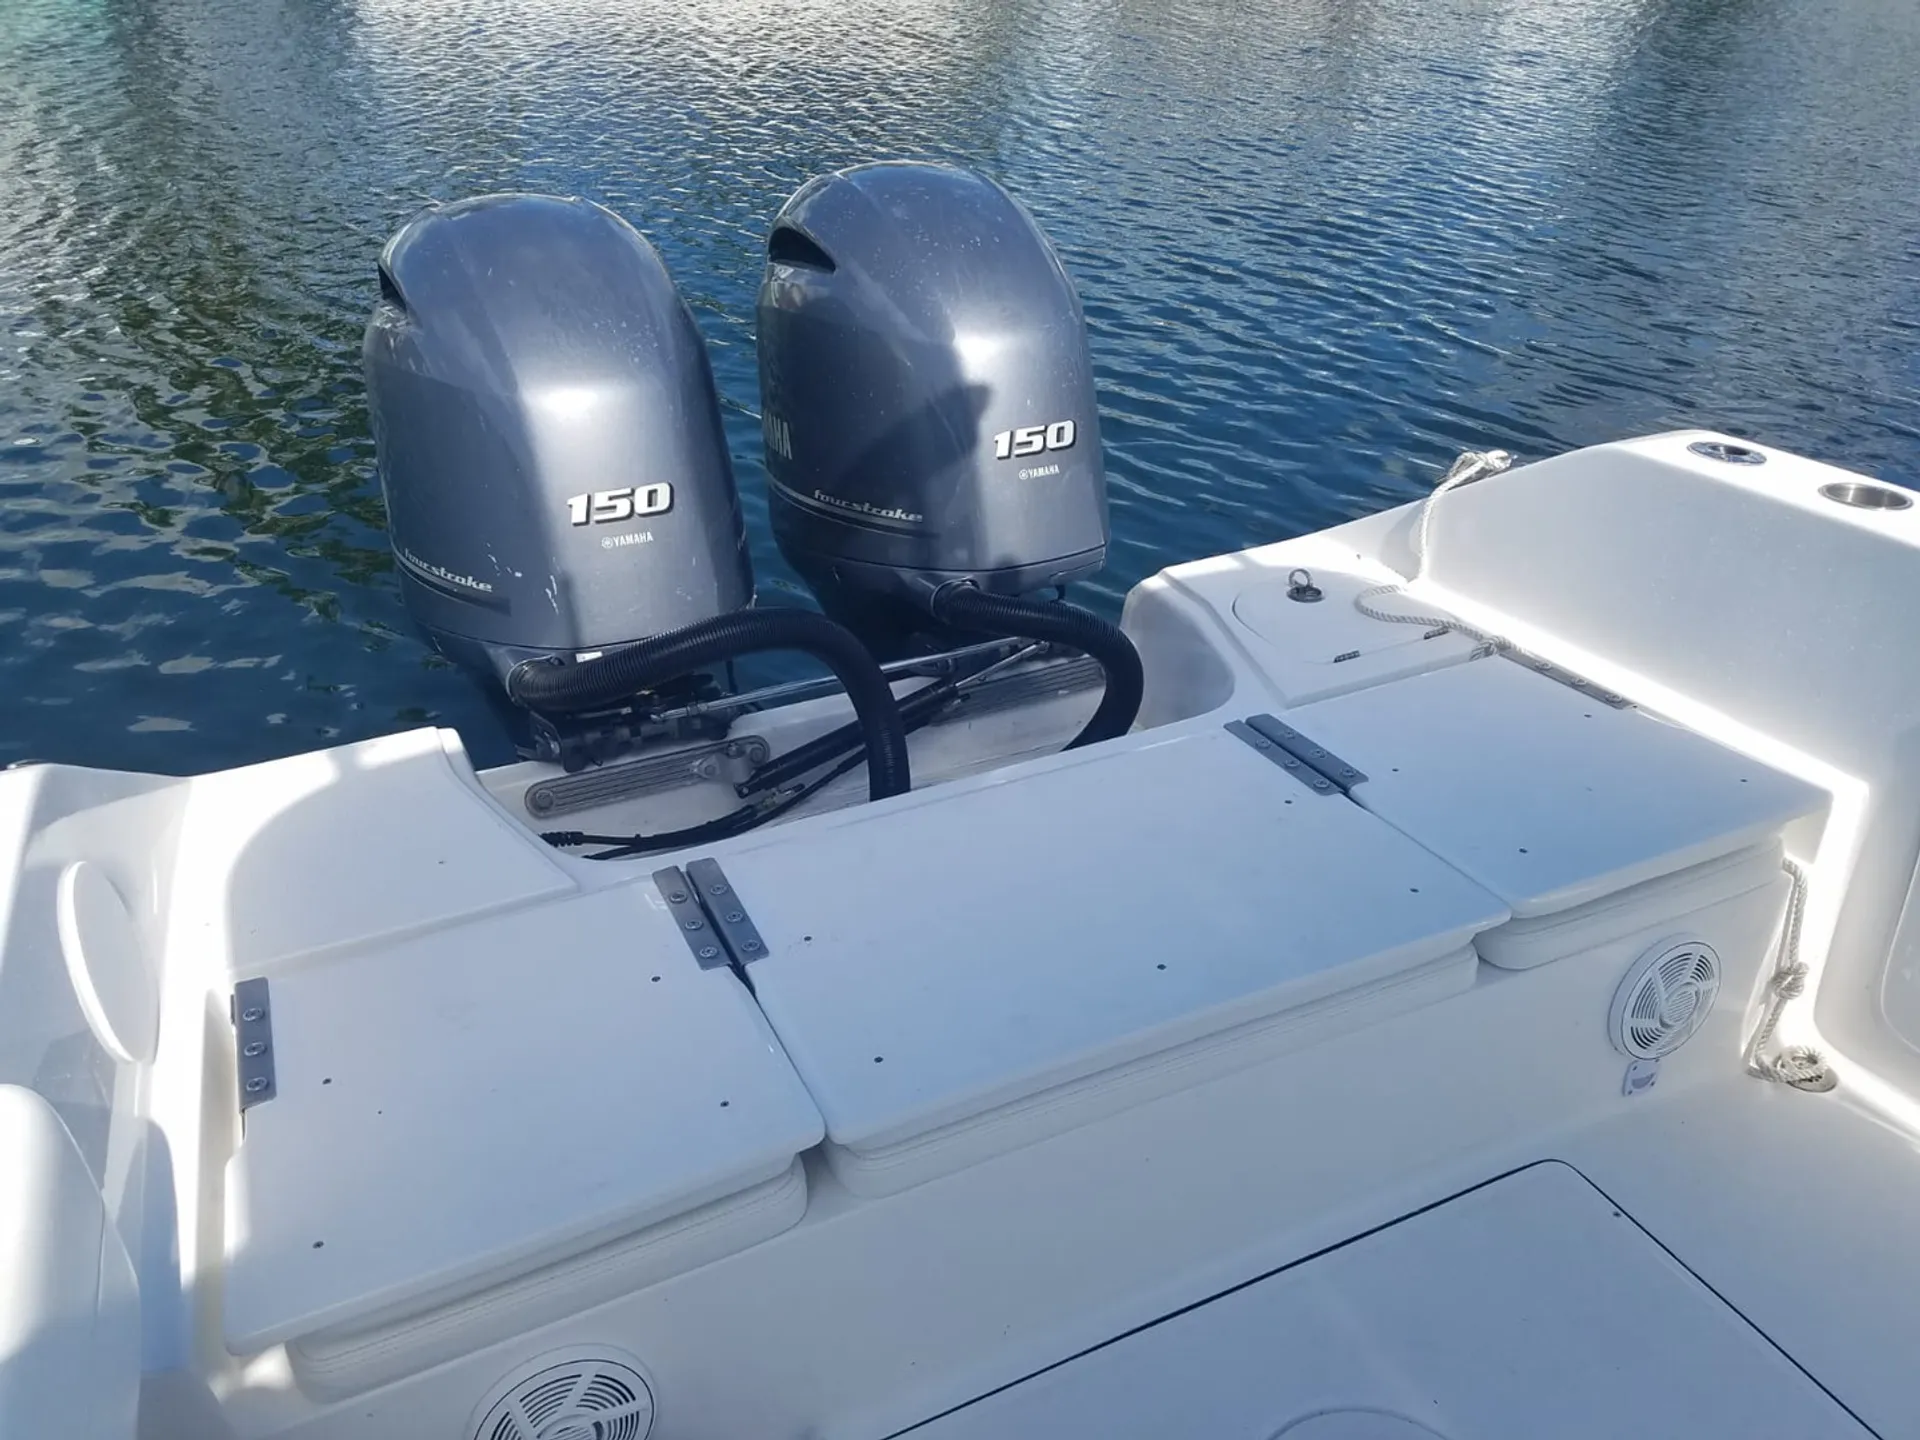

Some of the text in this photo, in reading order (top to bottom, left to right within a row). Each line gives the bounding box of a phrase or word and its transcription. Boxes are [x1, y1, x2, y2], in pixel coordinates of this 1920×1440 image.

[993, 419, 1076, 460] 150
[1028, 464, 1060, 479] YAMAHA
[567, 482, 674, 527] 150
[613, 531, 654, 547] YAMAHA
